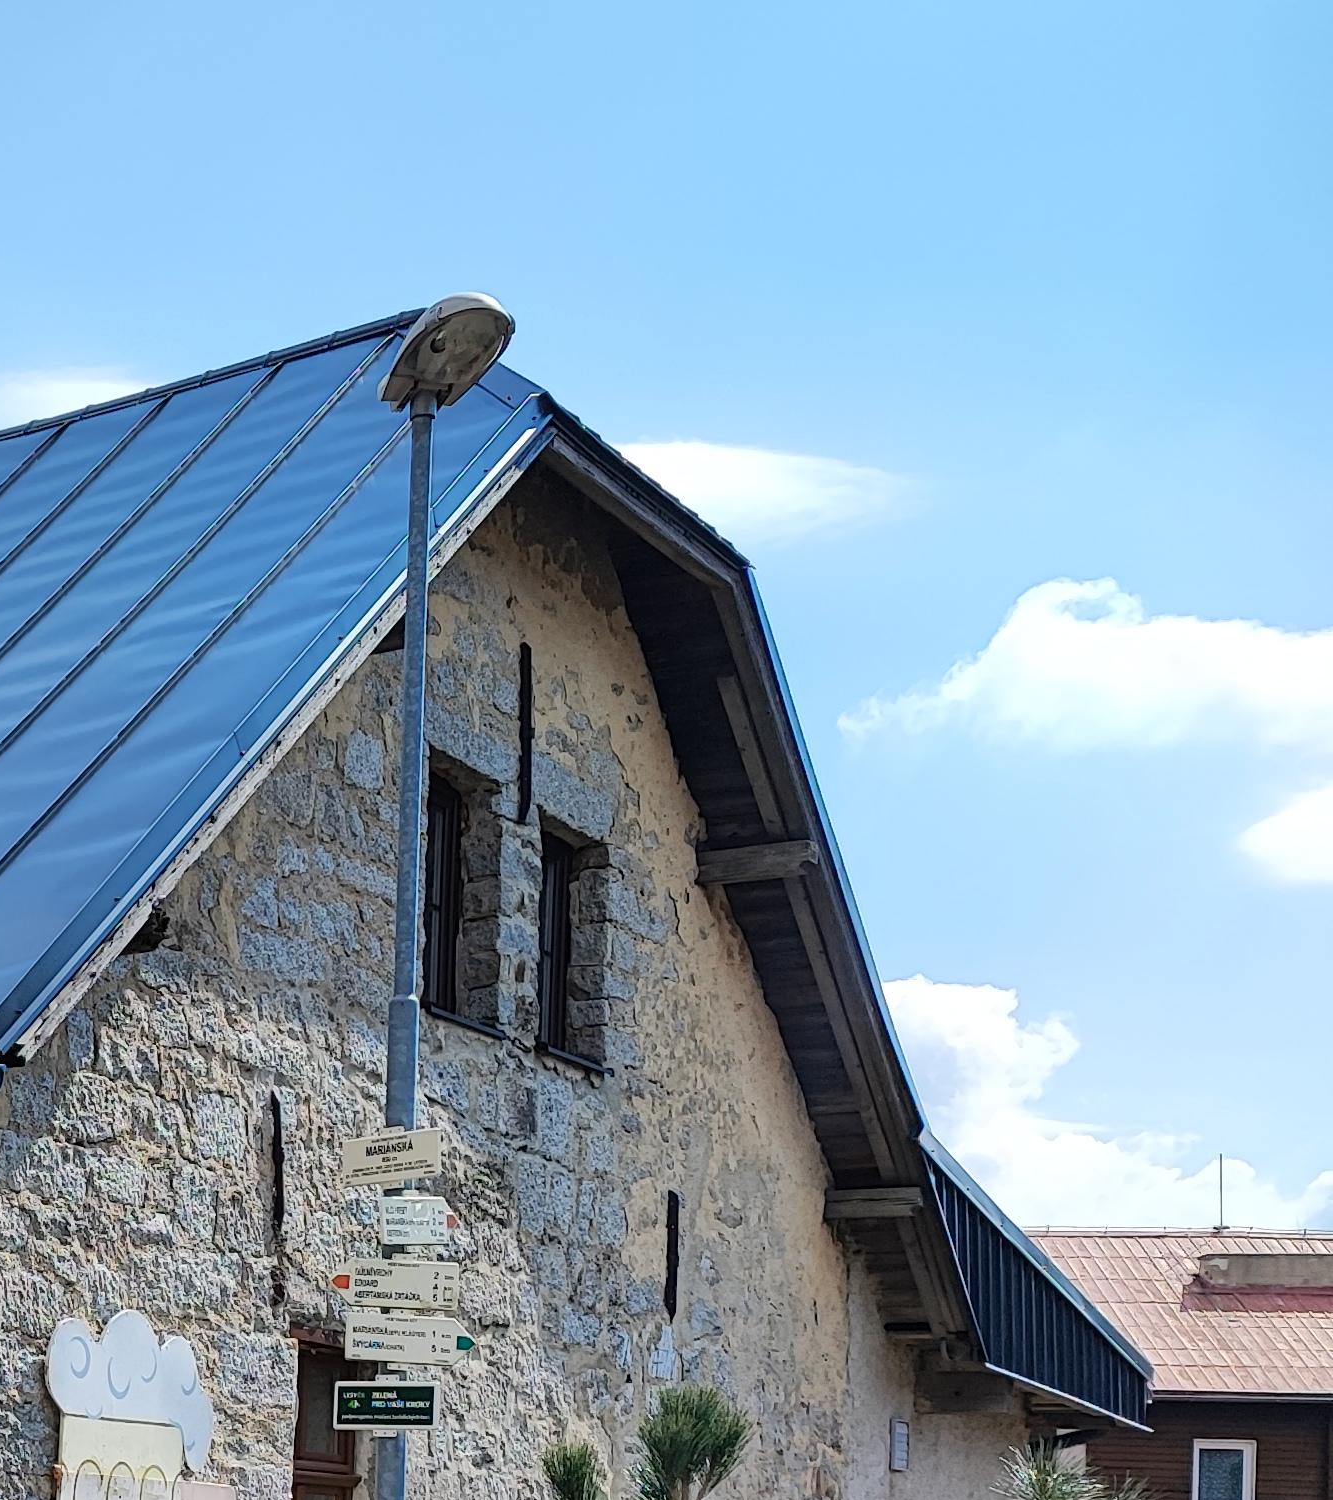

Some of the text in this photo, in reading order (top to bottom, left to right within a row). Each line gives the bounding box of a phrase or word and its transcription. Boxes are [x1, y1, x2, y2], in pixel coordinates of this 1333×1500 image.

[433, 1271, 440, 1280] 2
[433, 1293, 438, 1302] 5
[432, 1330, 436, 1338] 1
